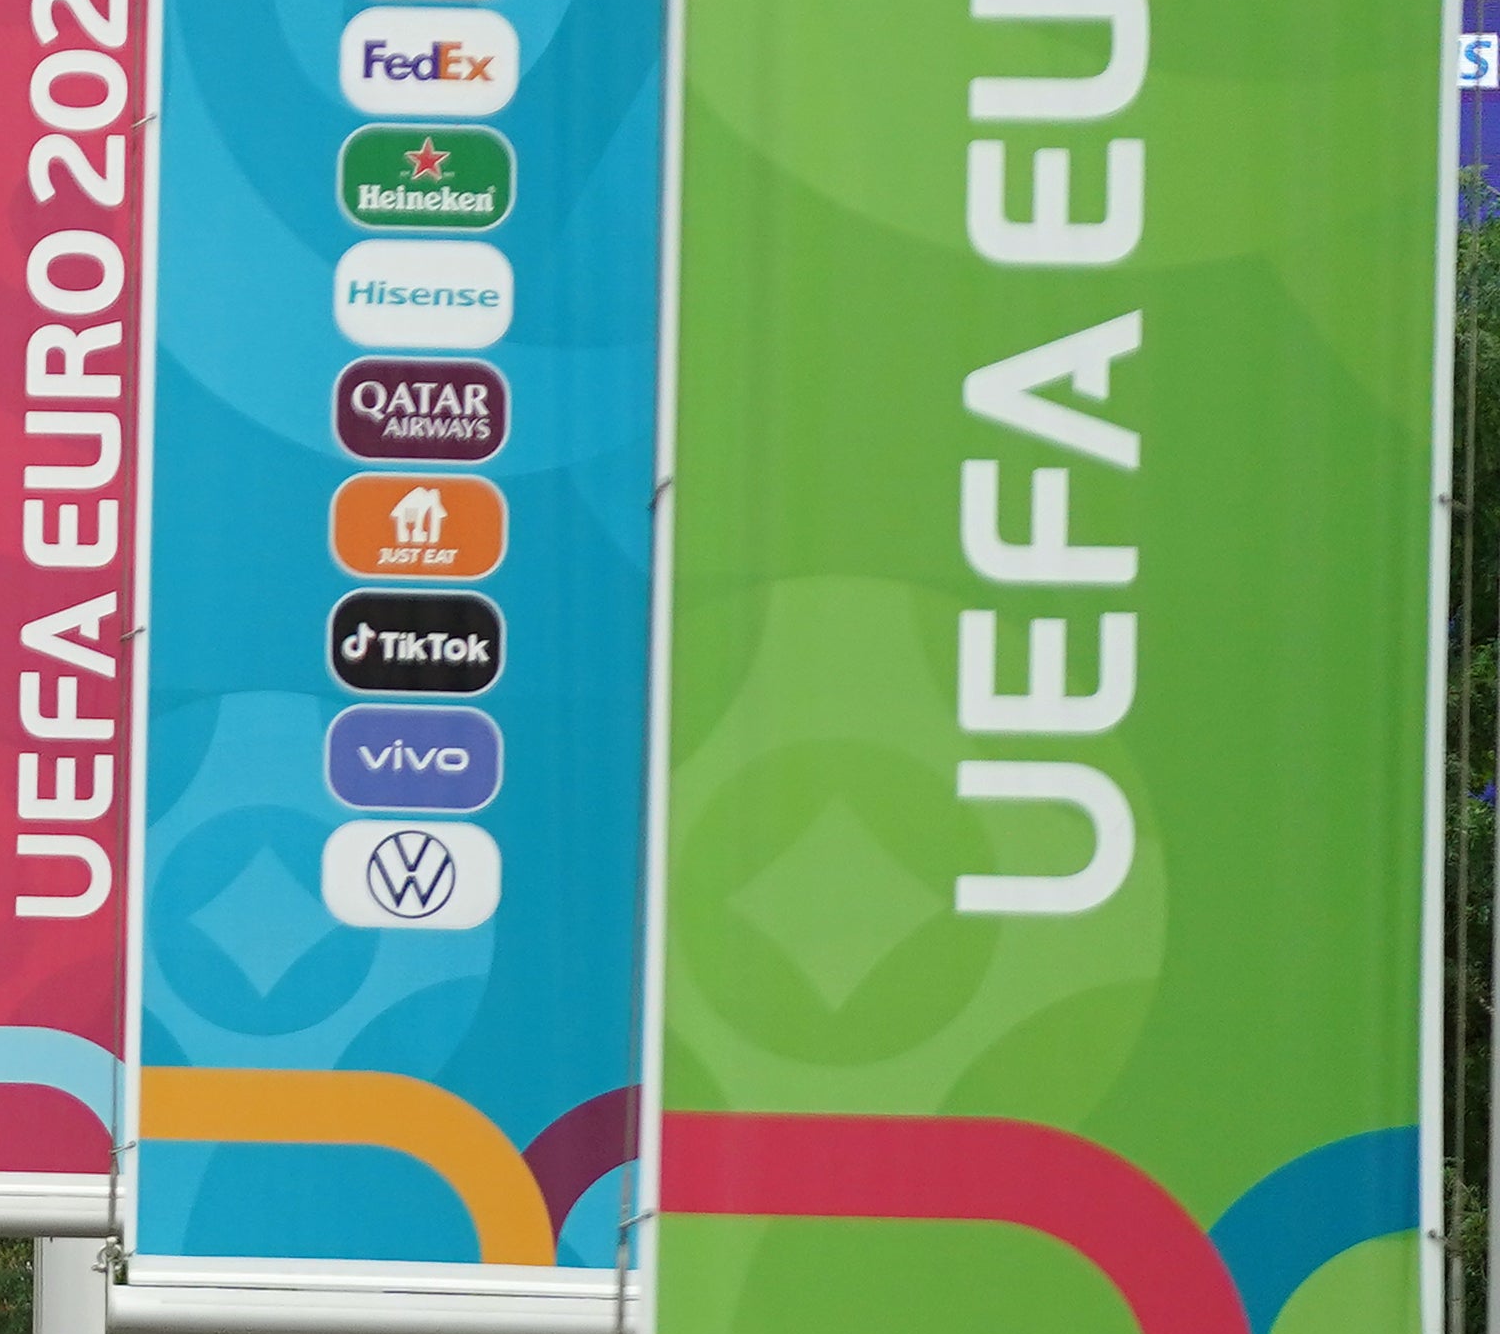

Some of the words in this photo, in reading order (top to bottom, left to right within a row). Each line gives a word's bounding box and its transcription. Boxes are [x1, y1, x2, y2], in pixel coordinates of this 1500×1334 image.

[362, 40, 495, 82] FedEx
[357, 183, 496, 213] Heineken
[348, 280, 501, 308] Hisense
[24, 229, 125, 570] EURO
[351, 380, 490, 422] QATAR
[382, 415, 492, 440] AIRWAYS
[377, 547, 421, 565] JUST
[424, 548, 459, 565] EAT
[954, 307, 1143, 914] UEFA
[378, 631, 490, 663] TikTok
[15, 590, 118, 919] UEFA
[358, 740, 471, 772] vivo
